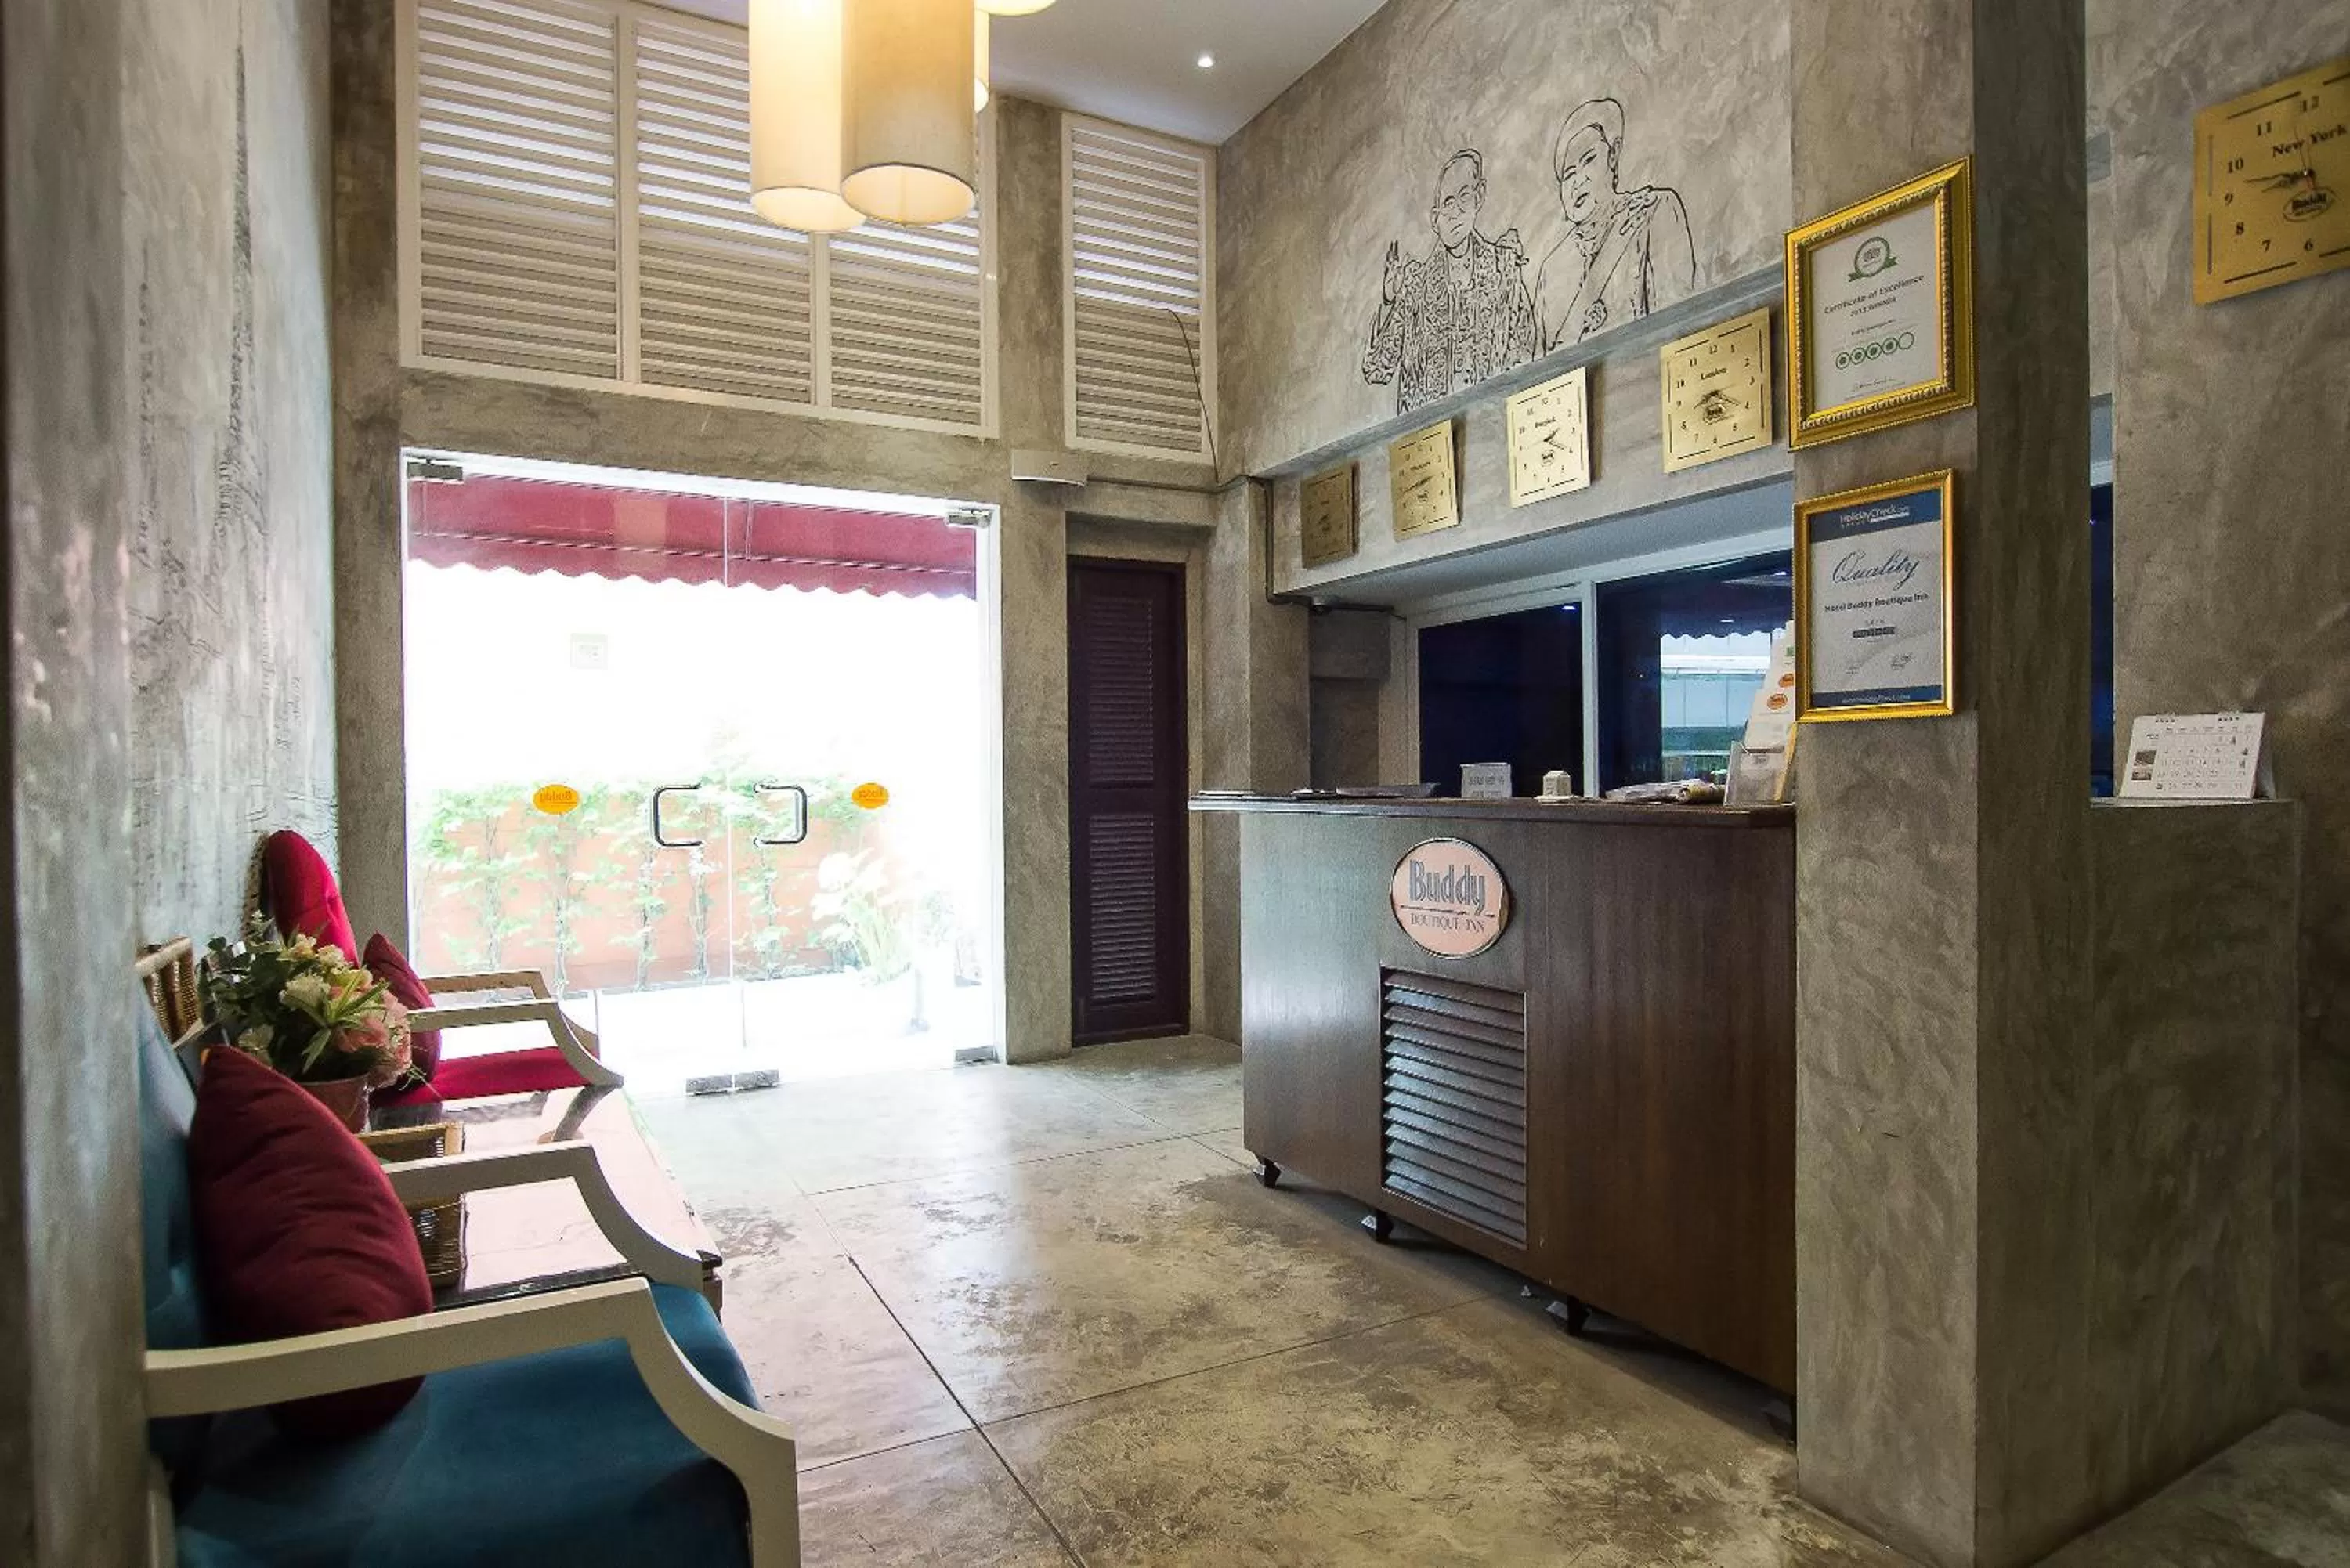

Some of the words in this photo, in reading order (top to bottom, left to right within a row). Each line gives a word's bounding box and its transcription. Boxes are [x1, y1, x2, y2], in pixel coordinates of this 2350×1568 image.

[2256, 121, 2272, 137] 11
[2272, 139, 2305, 157] New
[2310, 123, 2347, 144] York
[2227, 157, 2244, 174] 10
[2224, 193, 2234, 207] 9
[2235, 222, 2245, 236] 8
[2261, 239, 2271, 253] 7
[2304, 238, 2313, 251] 6
[1832, 549, 1920, 591] Quality
[1410, 860, 1486, 916] Buddy
